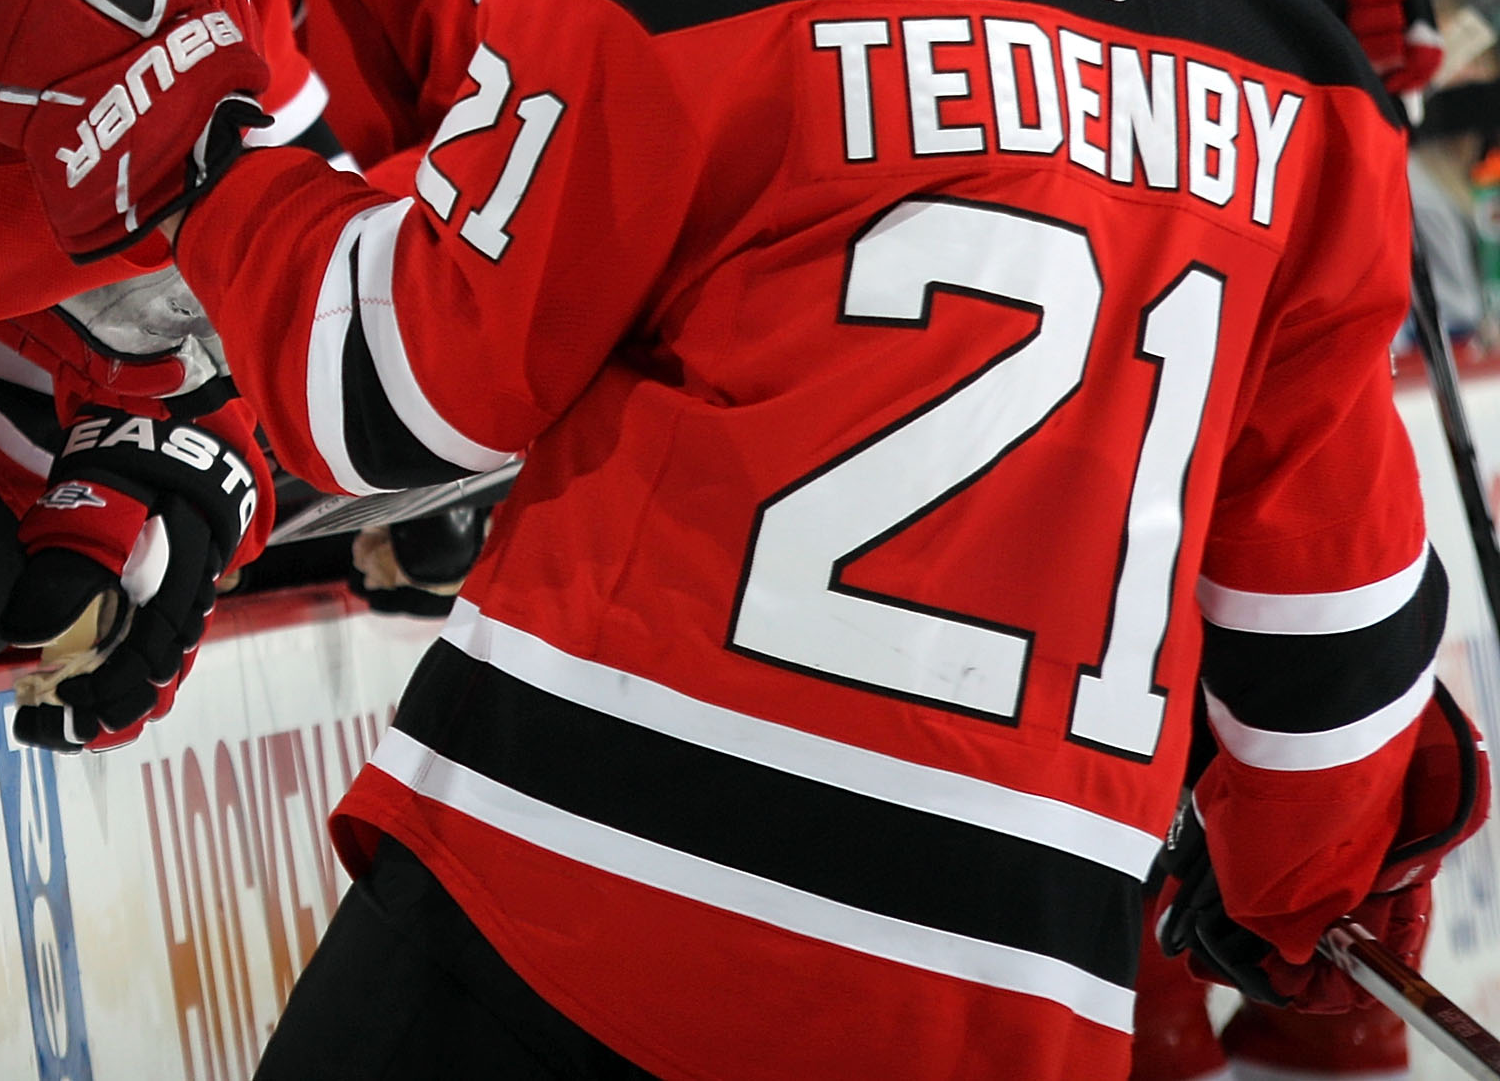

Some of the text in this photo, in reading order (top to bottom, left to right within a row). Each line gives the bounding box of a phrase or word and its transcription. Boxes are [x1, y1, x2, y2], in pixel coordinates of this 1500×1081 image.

[55, 9, 244, 189] BAUER
[415, 41, 567, 265] 21
[812, 16, 1304, 227] TEDENBY
[61, 416, 257, 540] EASTO
[725, 194, 1228, 764] 21
